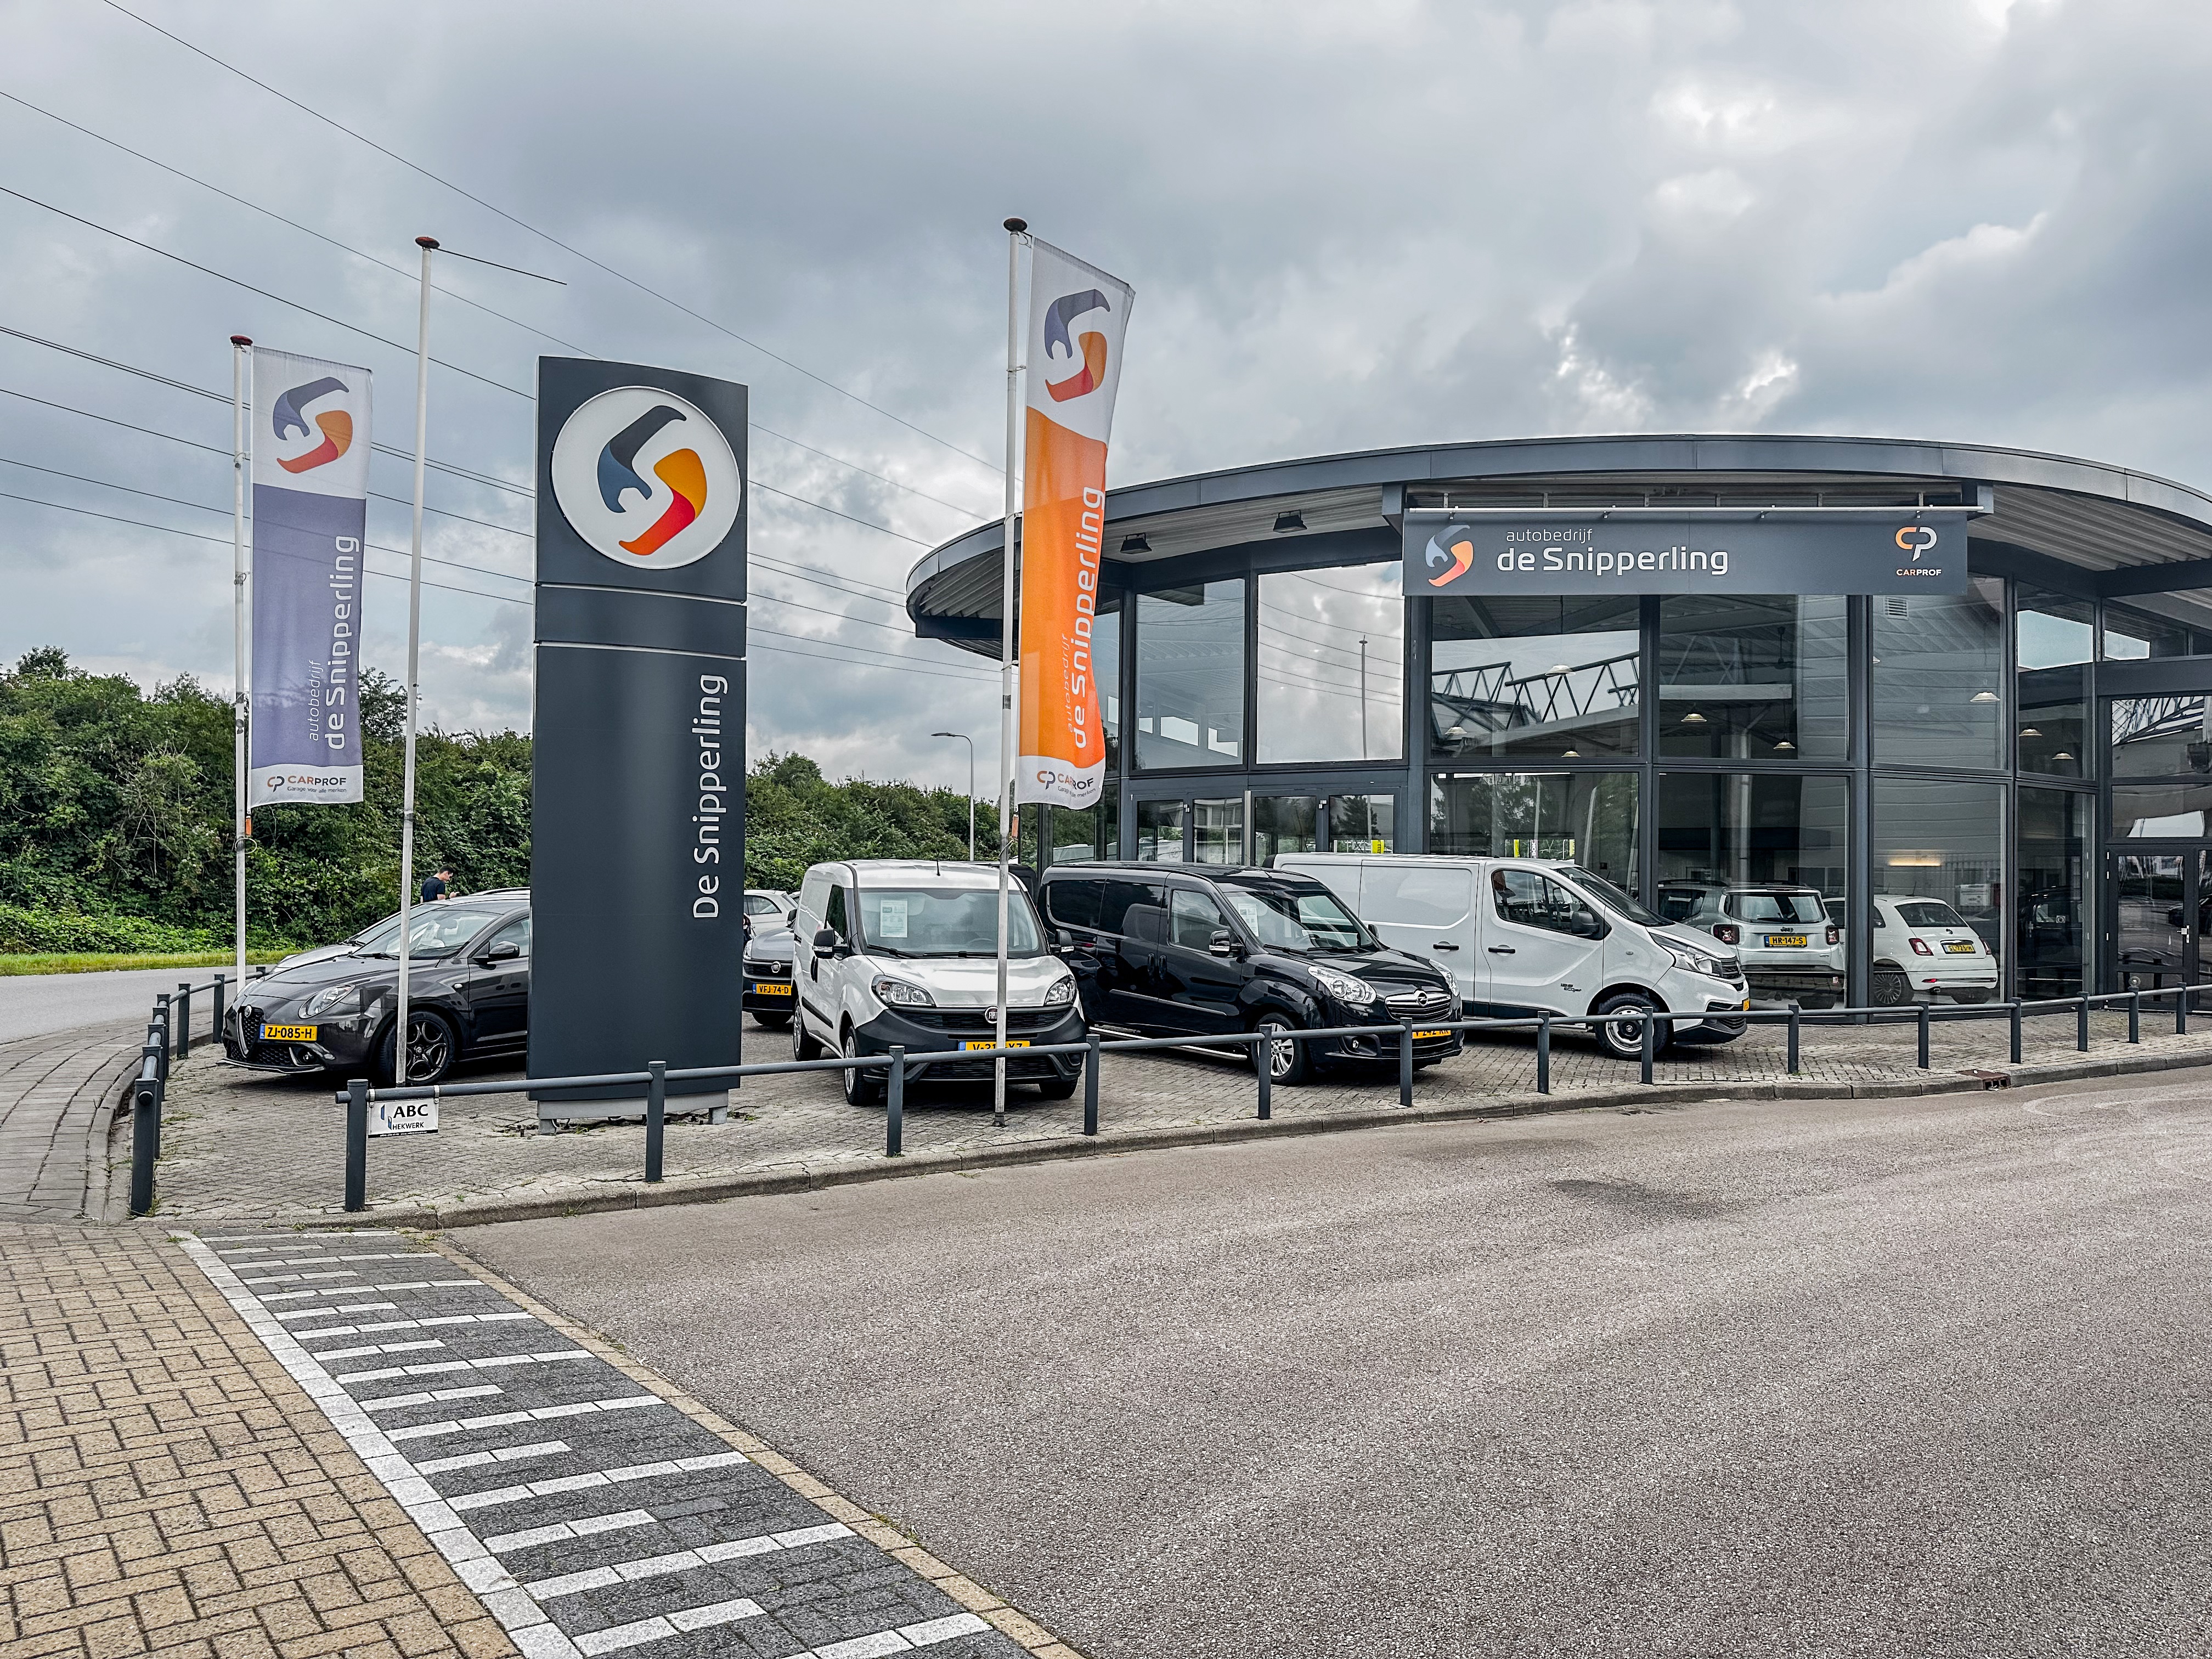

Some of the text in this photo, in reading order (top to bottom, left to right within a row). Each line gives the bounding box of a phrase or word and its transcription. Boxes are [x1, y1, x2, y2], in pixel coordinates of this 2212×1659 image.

[1506, 528, 1593, 544] autobedrijf
[1497, 546, 1729, 576] de Snipperling
[1070, 487, 1104, 749] de Snipperling
[324, 535, 360, 750] de Snipperling
[1062, 633, 1074, 733] autobedrijf
[307, 659, 324, 741] autobedrijf
[287, 775, 347, 786] CARPROF
[692, 674, 728, 918] De Snipperling
[759, 985, 789, 994] VFJ-74-D
[267, 1026, 312, 1039] ZJ-085-H
[393, 1104, 428, 1119] ABC
[392, 1121, 424, 1130] HEKWERK
